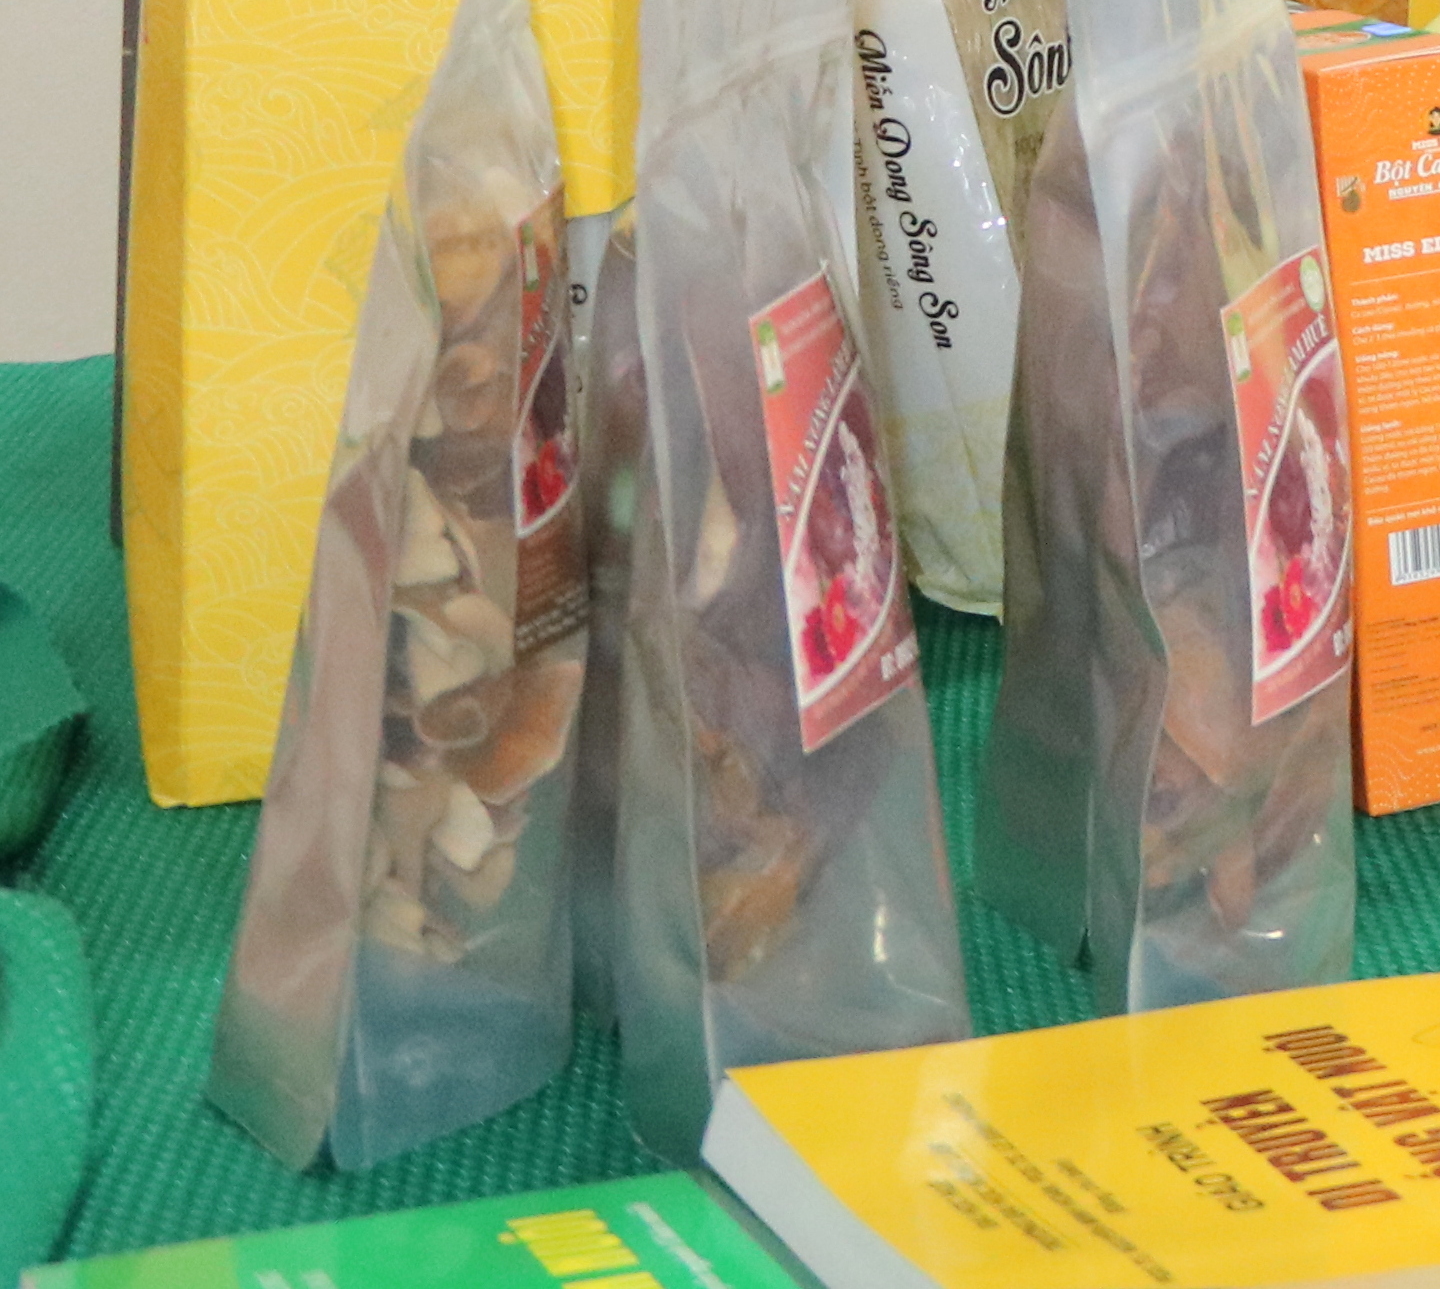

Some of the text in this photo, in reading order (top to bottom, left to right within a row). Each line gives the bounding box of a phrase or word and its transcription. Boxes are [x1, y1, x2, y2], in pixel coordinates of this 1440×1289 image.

[854, 28, 893, 113] Miến
[872, 116, 913, 204] Dong
[1373, 157, 1412, 188] Bột
[899, 210, 938, 285] Sông
[1362, 242, 1416, 265] MISS
[1262, 1024, 1388, 1081] NUÔI
[1196, 1088, 1403, 1212] DI TRUYỀN
